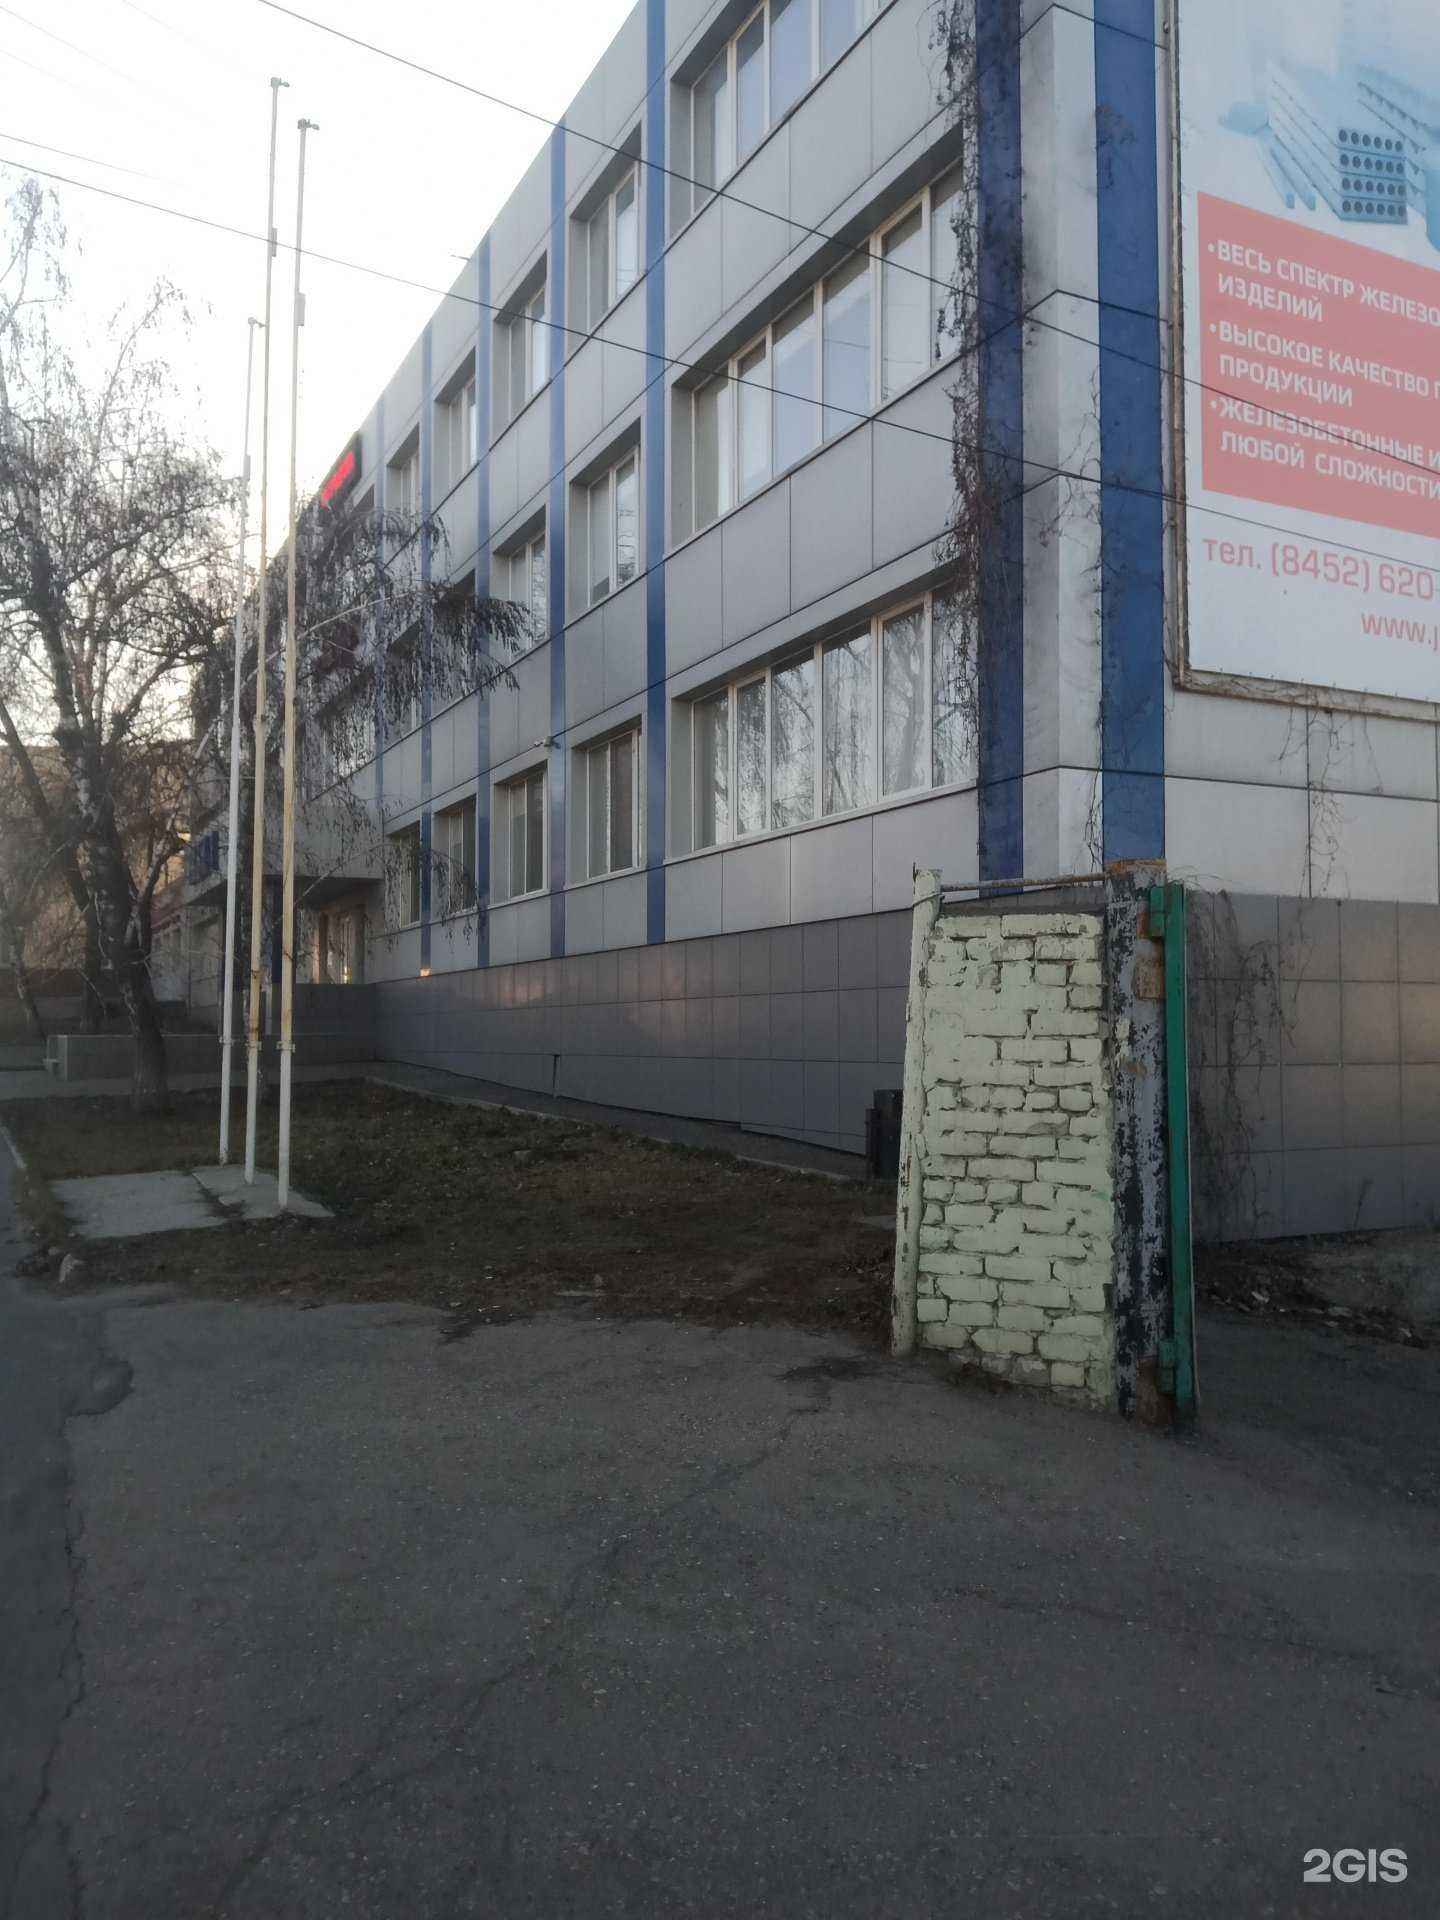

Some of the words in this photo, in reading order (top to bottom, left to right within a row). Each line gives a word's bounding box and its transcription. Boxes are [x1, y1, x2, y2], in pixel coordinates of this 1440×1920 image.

[1218, 272, 1323, 322] ИЗДЕЛИЙ
[1277, 258, 1354, 298] СПЕКТР
[1220, 355, 1353, 407] ПРОДУКЦИИ
[1329, 350, 1429, 397] КАЧЕСТВО
[1221, 430, 1304, 469] ЛЮБОЙ
[1315, 453, 1440, 500] СЛОЖНОСТИ
[1203, 538, 1261, 570] тел.
[1271, 542, 1370, 593] (8452)
